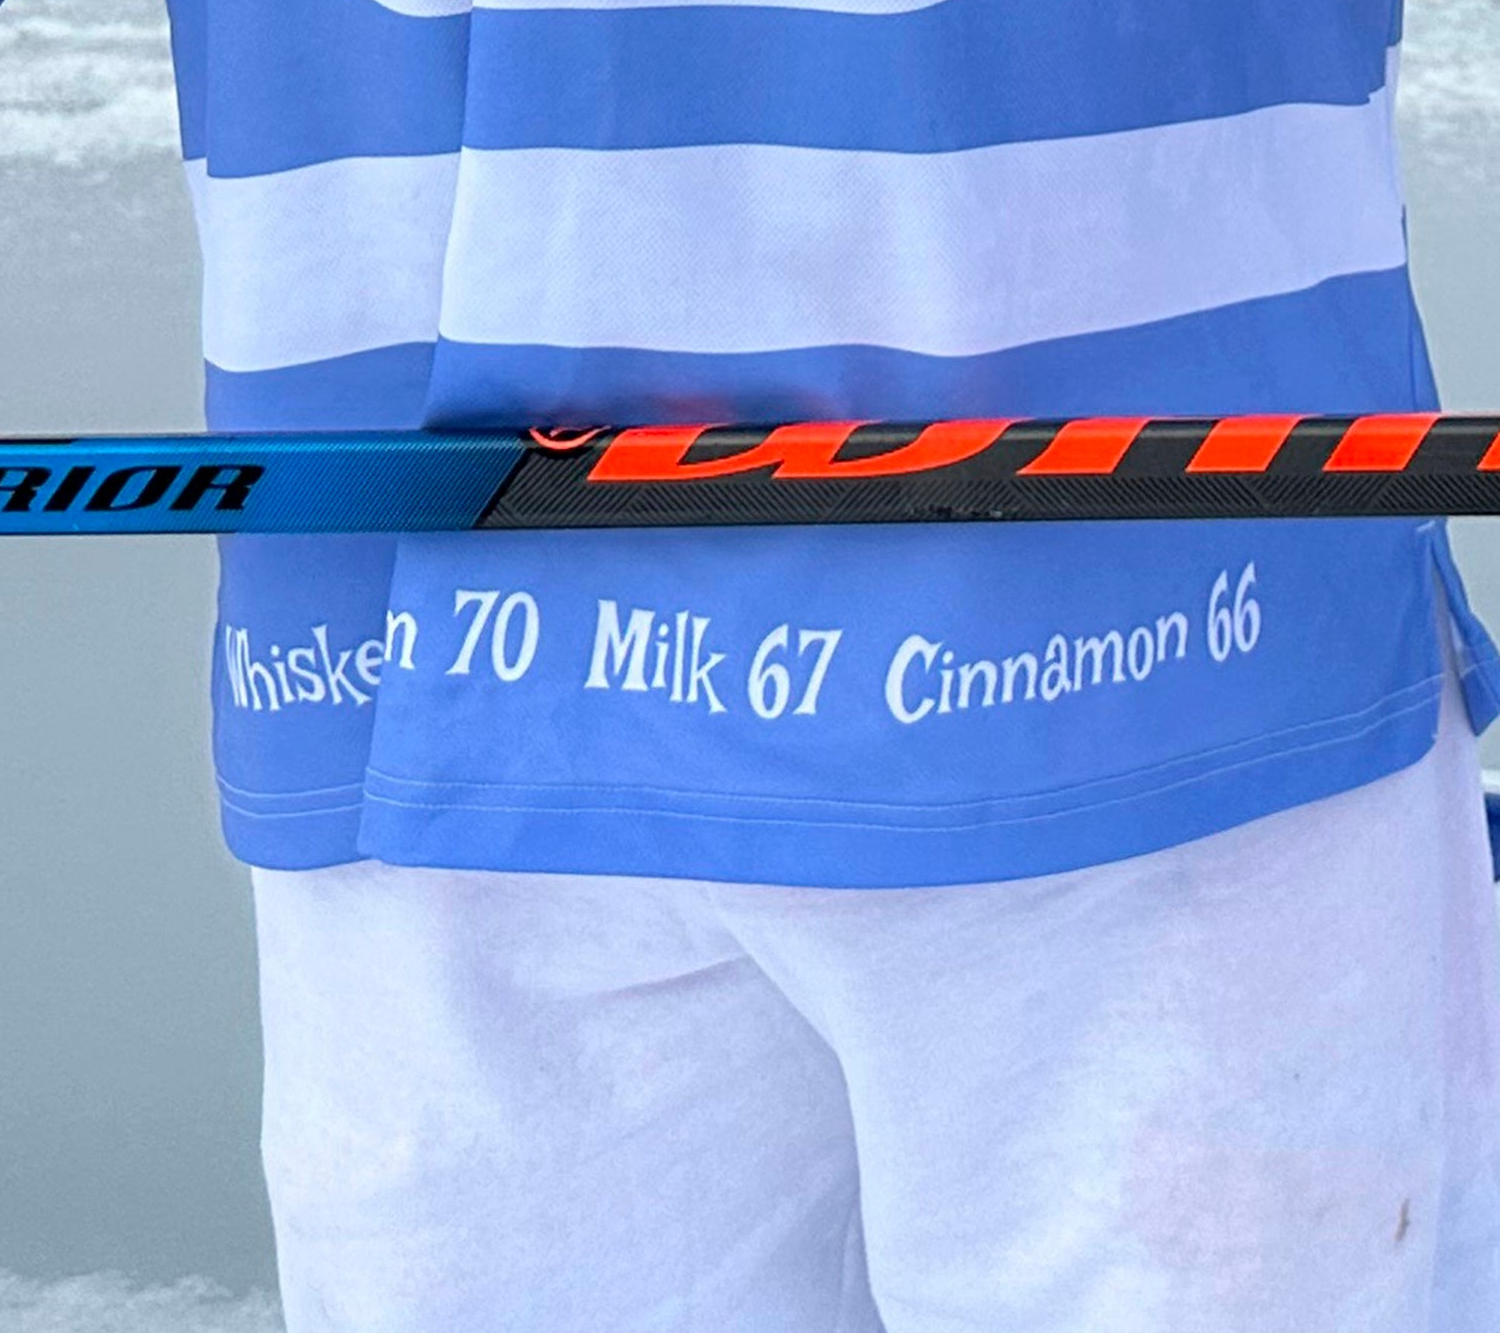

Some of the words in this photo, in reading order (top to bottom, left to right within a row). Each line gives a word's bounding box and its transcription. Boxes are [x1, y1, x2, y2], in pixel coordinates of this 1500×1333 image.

[445, 589, 541, 682] 70
[584, 598, 728, 714] Milk
[747, 623, 843, 720] 67
[884, 609, 1190, 724] Cinnamon
[1206, 561, 1262, 663] 66
